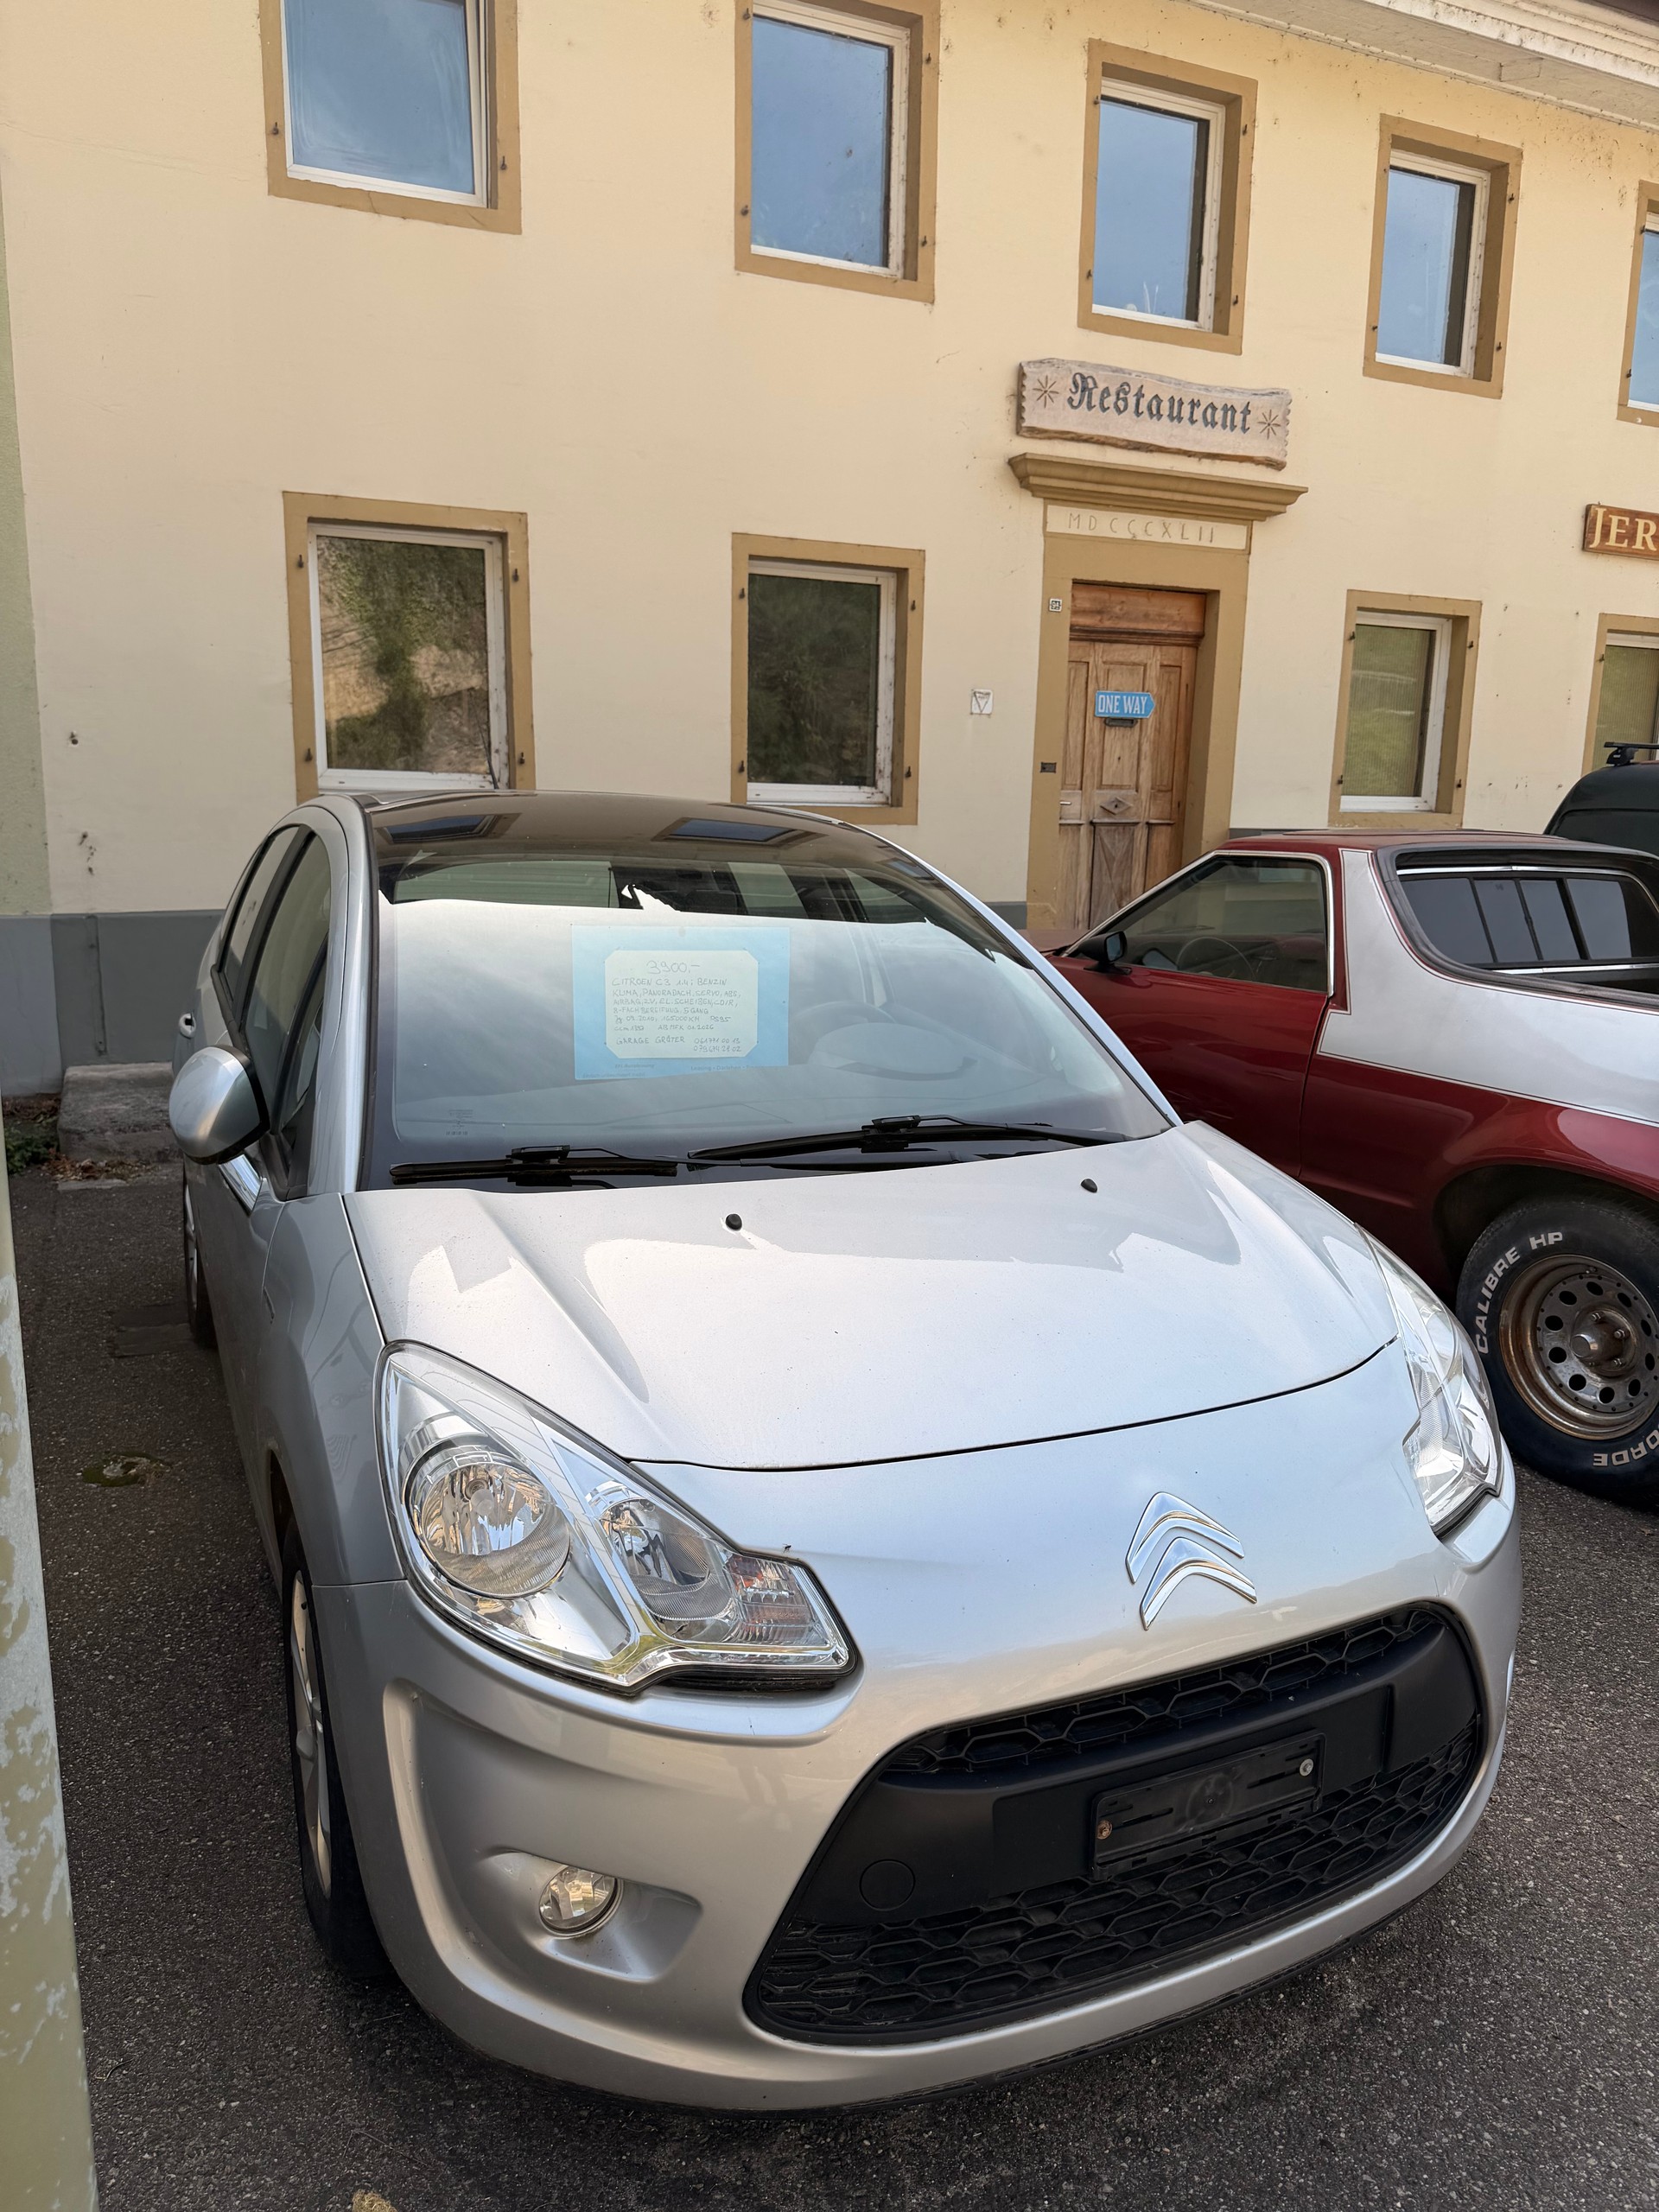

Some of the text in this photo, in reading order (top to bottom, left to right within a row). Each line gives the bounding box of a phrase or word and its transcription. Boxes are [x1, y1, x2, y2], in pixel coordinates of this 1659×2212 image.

[1067, 372, 1251, 434] Restaurant
[1589, 507, 1658, 551] JER
[1097, 695, 1148, 715] ONE WAY
[697, 976, 728, 986] BENZIN
[1476, 1231, 1563, 1354] CALIBRE HP
[1592, 1425, 1659, 1466] ORDE
